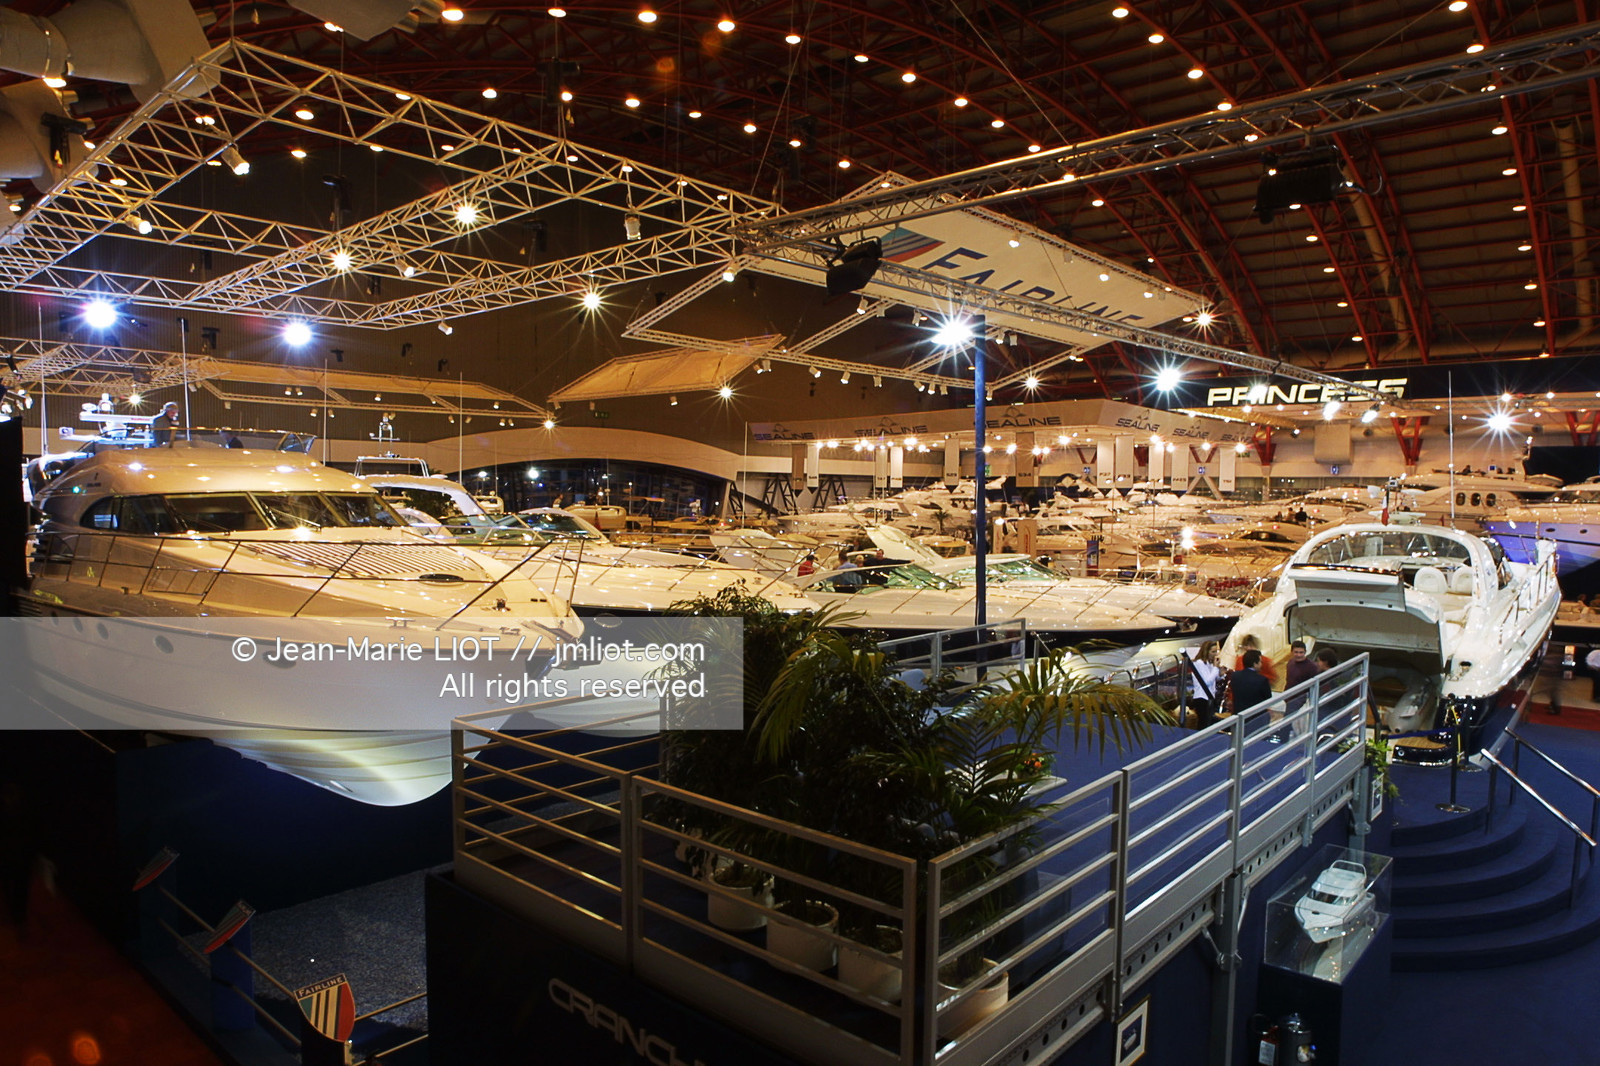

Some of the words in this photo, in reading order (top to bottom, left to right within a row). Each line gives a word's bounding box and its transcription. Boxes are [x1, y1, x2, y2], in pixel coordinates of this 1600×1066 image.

[974, 416, 1062, 429] EALINE
[1115, 418, 1160, 432] SEALINE
[754, 432, 815, 440] SEALINE
[855, 425, 928, 437] SEALINE
[1172, 428, 1210, 439] SEALINE
[298, 977, 343, 997] FAIRLINE
